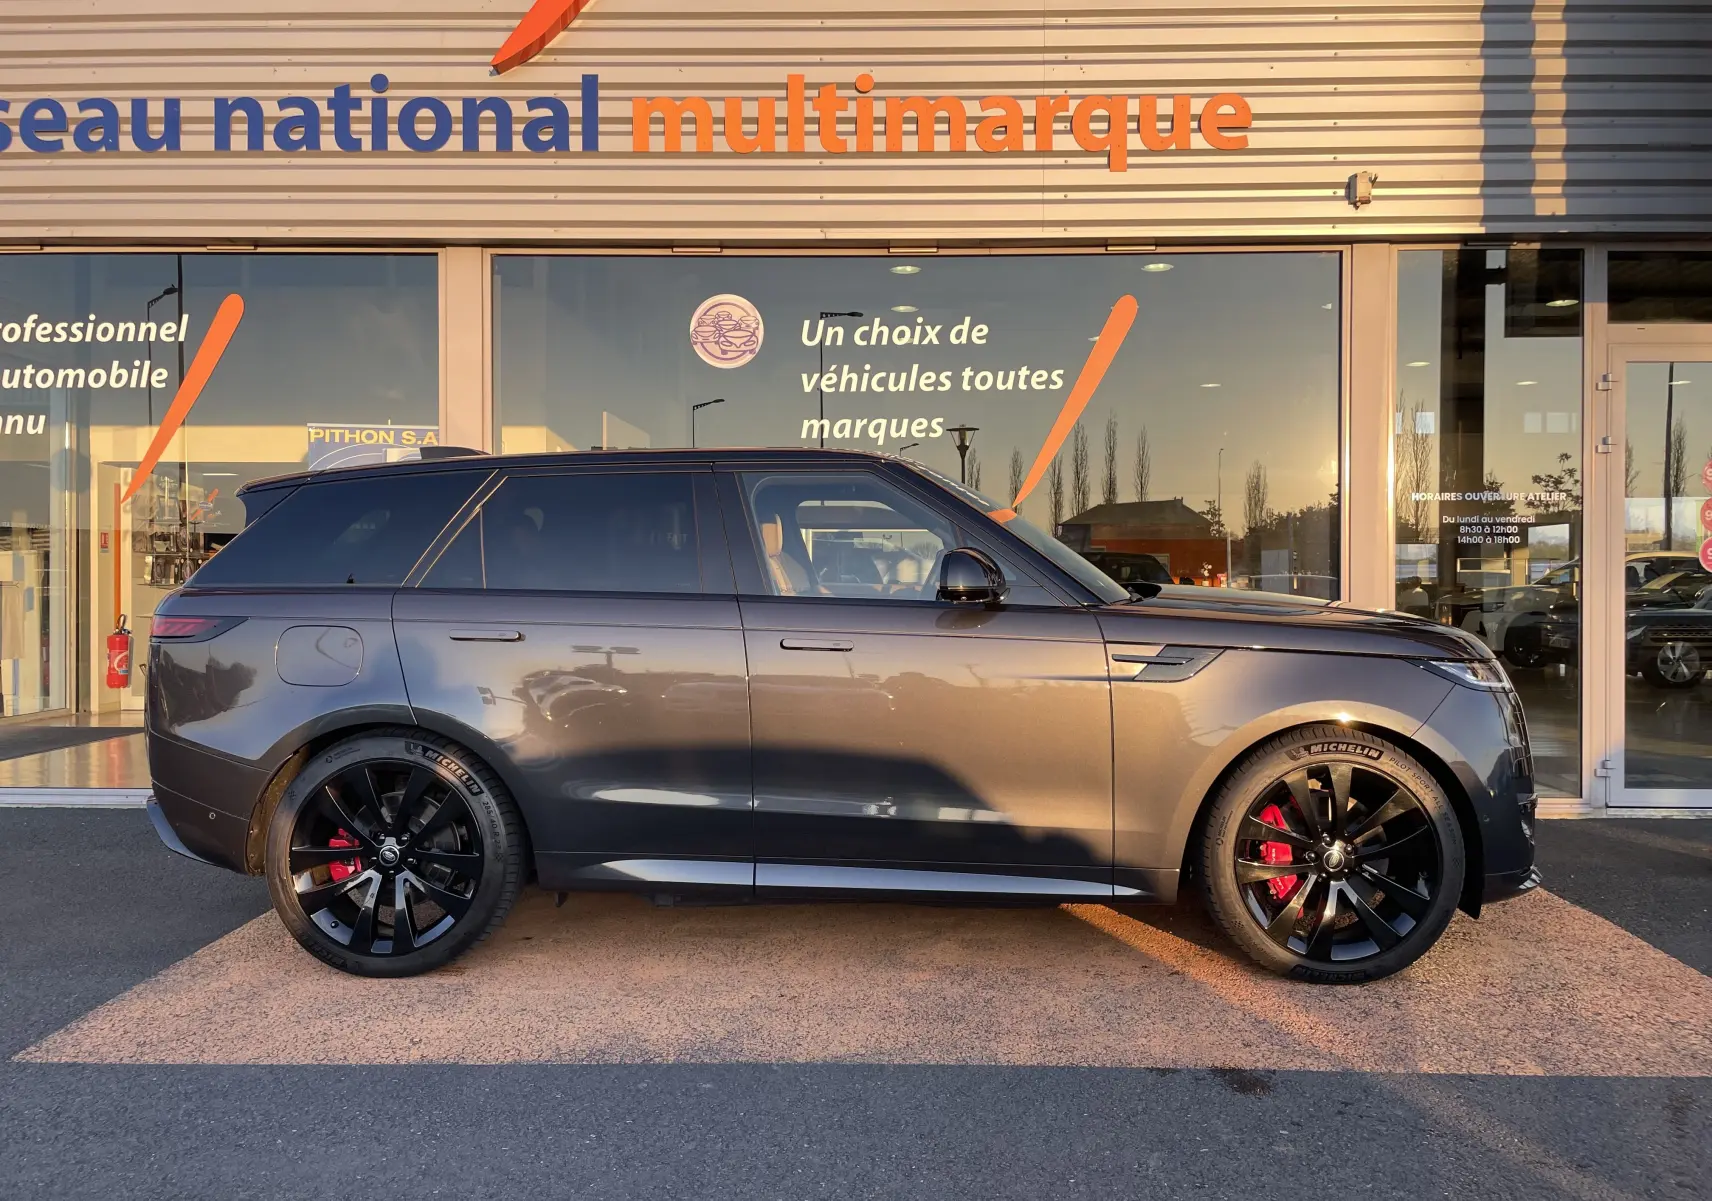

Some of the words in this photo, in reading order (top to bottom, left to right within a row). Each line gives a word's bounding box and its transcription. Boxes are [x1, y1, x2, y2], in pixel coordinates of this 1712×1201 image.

[214, 74, 599, 153] national
[632, 73, 1253, 172] multimarque
[0, 313, 189, 343] ofessionnel
[801, 319, 844, 346] Un
[853, 317, 941, 347] choix
[949, 316, 989, 346] de
[801, 364, 953, 392] véhicules
[961, 367, 1064, 391] toutes
[0, 414, 46, 435] nu
[310, 429, 395, 444] PITHON
[801, 417, 944, 446] marques
[1411, 492, 1463, 501] HORAIRES
[1526, 492, 1567, 501] ATELIER
[1442, 515, 1455, 523] Du
[1456, 515, 1479, 523] lundi
[1495, 515, 1536, 523] vendredi
[1459, 525, 1482, 534] 8h30
[1484, 525, 1491, 534] à
[1492, 525, 1518, 534] 12h00
[1457, 535, 1484, 544] 14h00
[1485, 535, 1492, 544] à
[1493, 535, 1521, 544] 18h00
[1310, 743, 1381, 758] MICHELIN
[425, 750, 481, 794] MICHELIN
[1389, 756, 1411, 772] PILOT
[1412, 772, 1434, 794] SPORT
[1432, 795, 1444, 810] ALL
